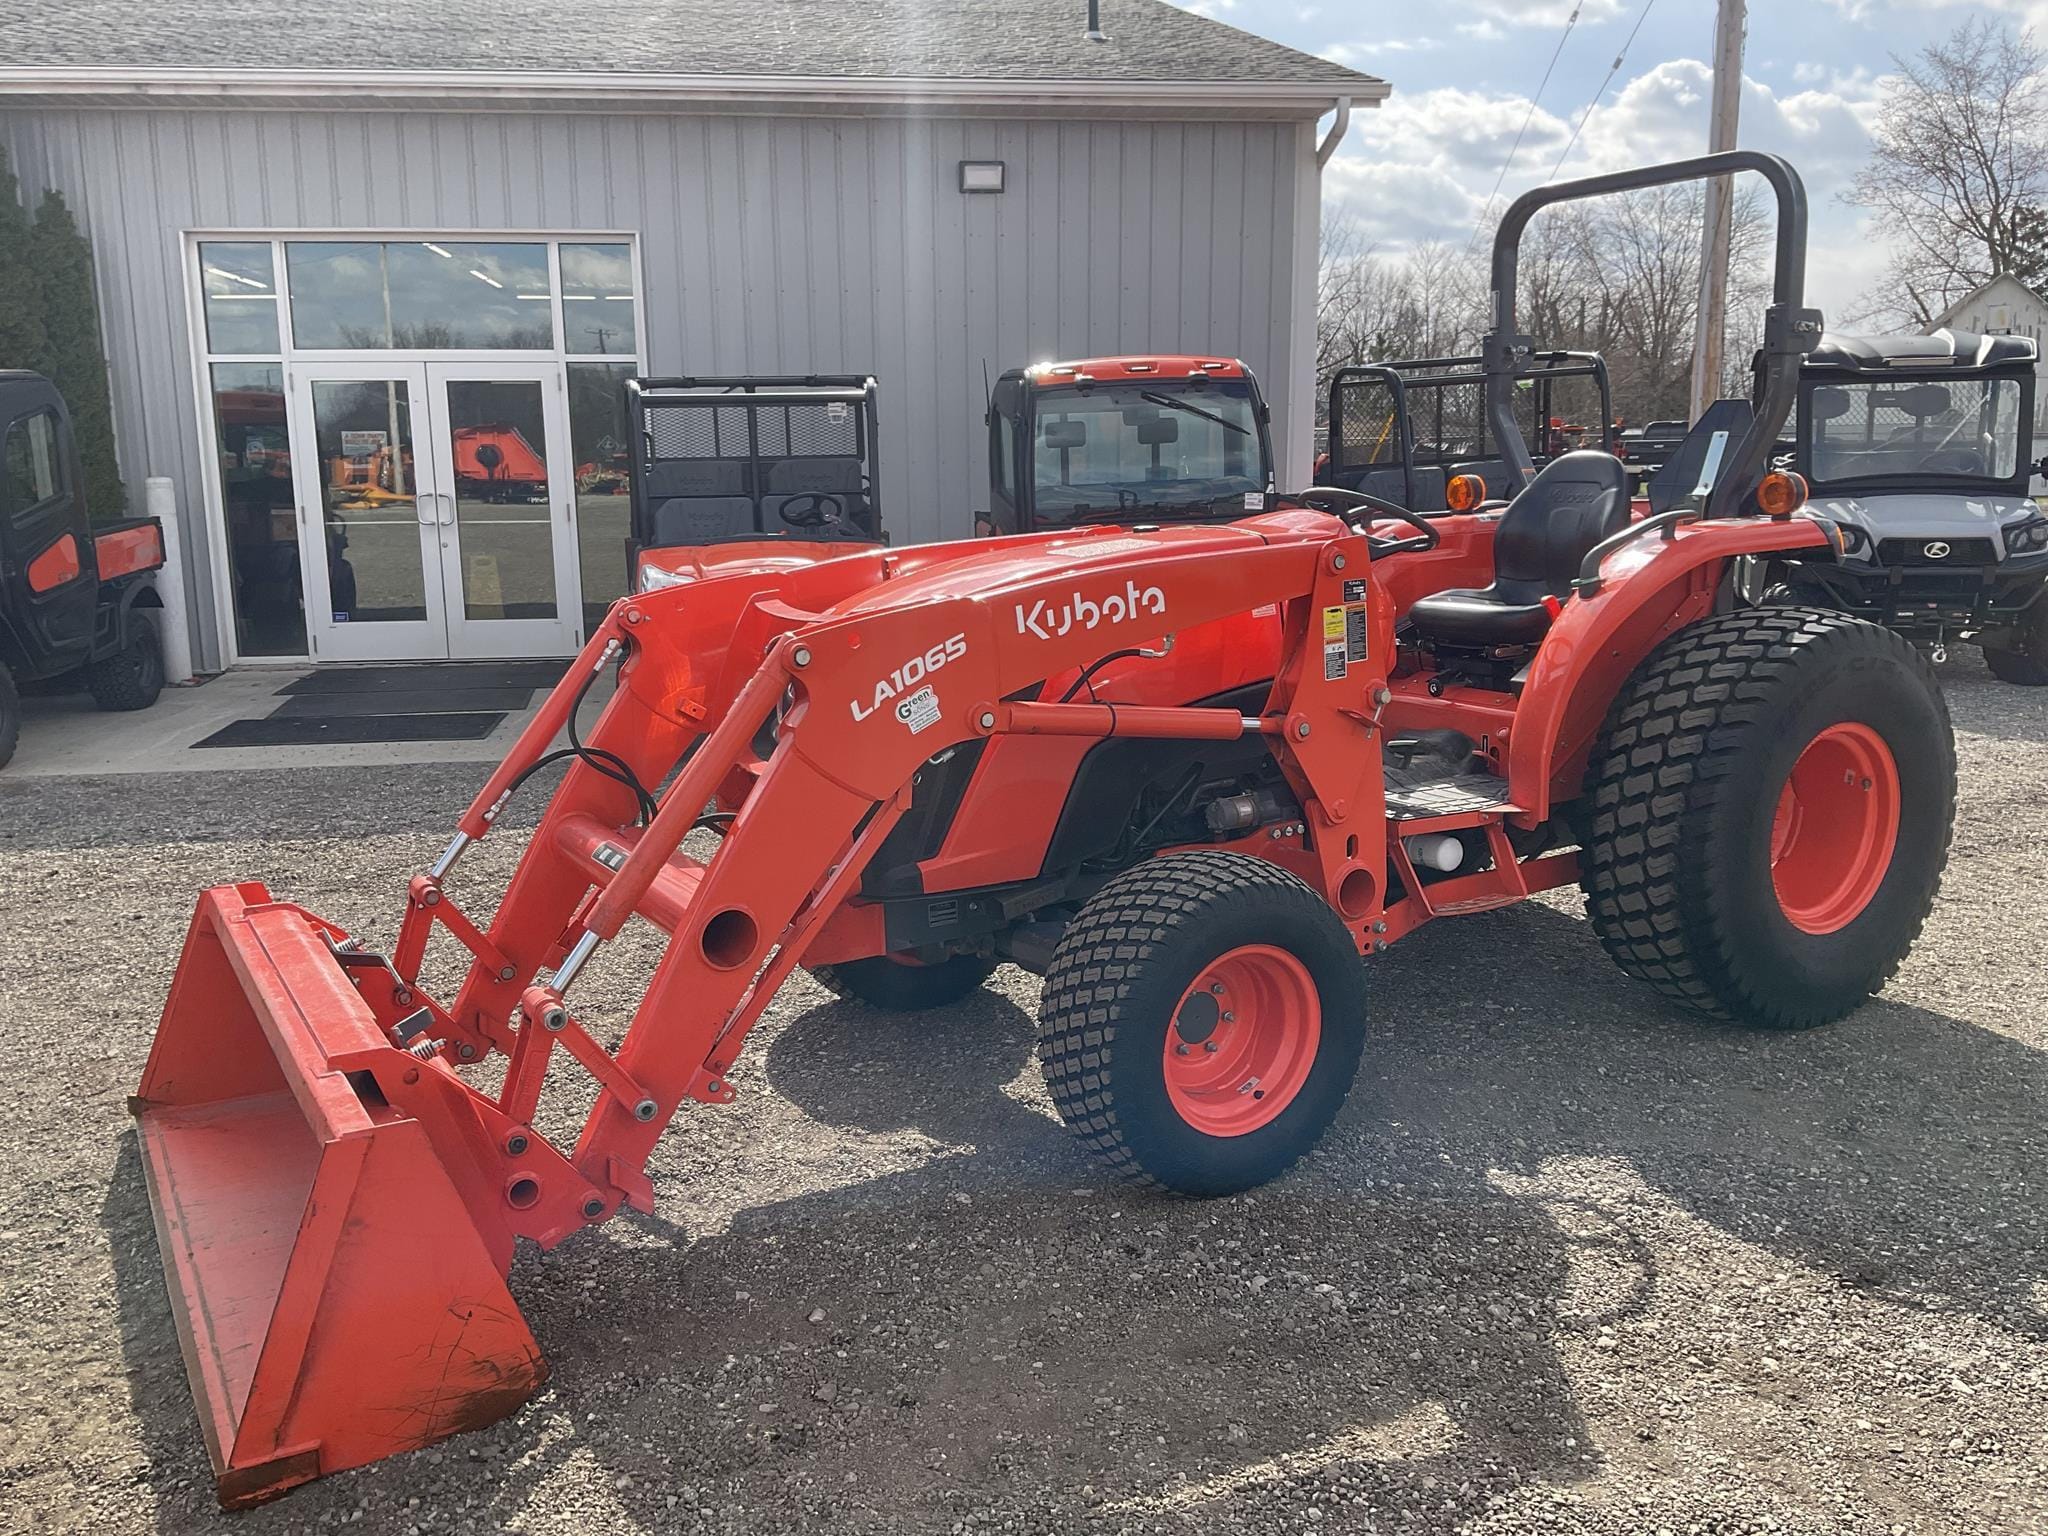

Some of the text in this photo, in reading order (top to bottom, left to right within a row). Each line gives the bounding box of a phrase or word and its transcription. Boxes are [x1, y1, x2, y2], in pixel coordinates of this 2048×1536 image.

[1015, 580, 1166, 640] Kubota
[850, 632, 967, 722] LA1065
[898, 690, 930, 720] Green
